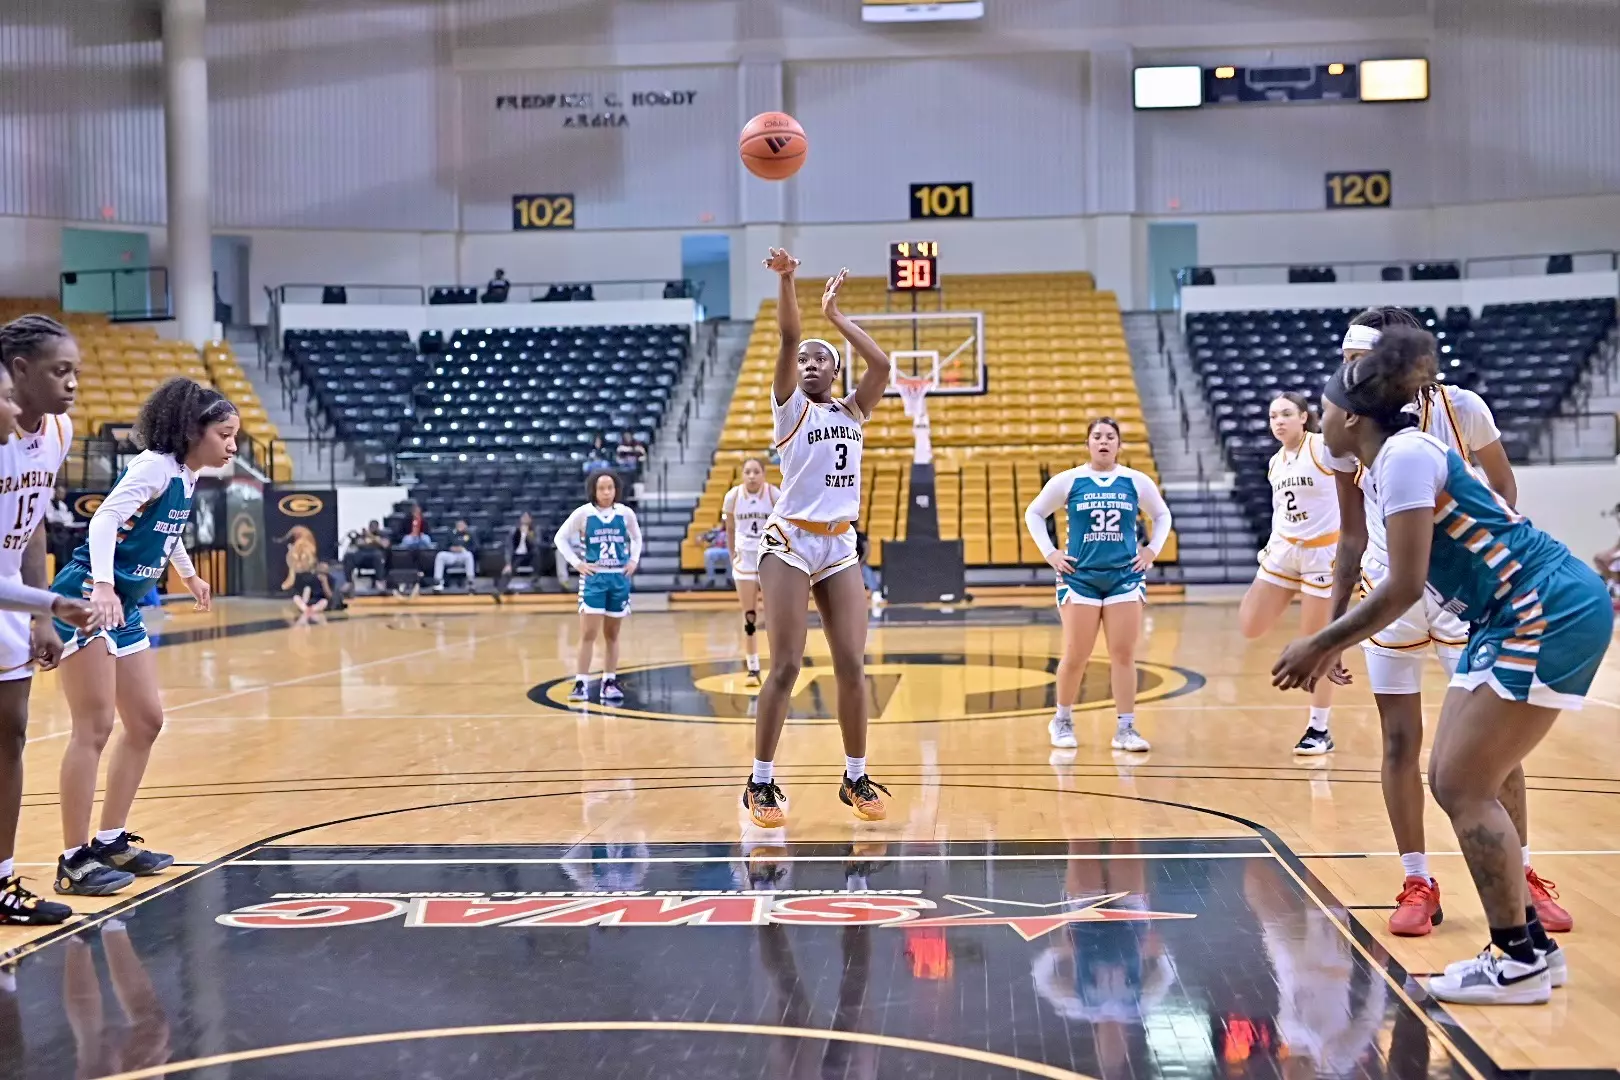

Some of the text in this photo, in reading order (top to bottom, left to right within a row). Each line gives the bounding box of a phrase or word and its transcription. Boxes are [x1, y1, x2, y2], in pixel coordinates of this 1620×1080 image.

[914, 185, 969, 216] 101
[1328, 174, 1389, 205] 120
[515, 197, 573, 227] 102
[896, 259, 931, 288] 30
[835, 443, 848, 471] 3
[825, 474, 855, 488] STATE
[13, 492, 39, 530] 15
[1284, 490, 1297, 511] 2
[751, 521, 758, 534] 4
[1090, 509, 1121, 532] 32
[1083, 532, 1124, 543] HOUSTON
[599, 542, 617, 559] 24
[269, 891, 486, 899] CONFERENCE
[215, 896, 936, 928] SWAC
